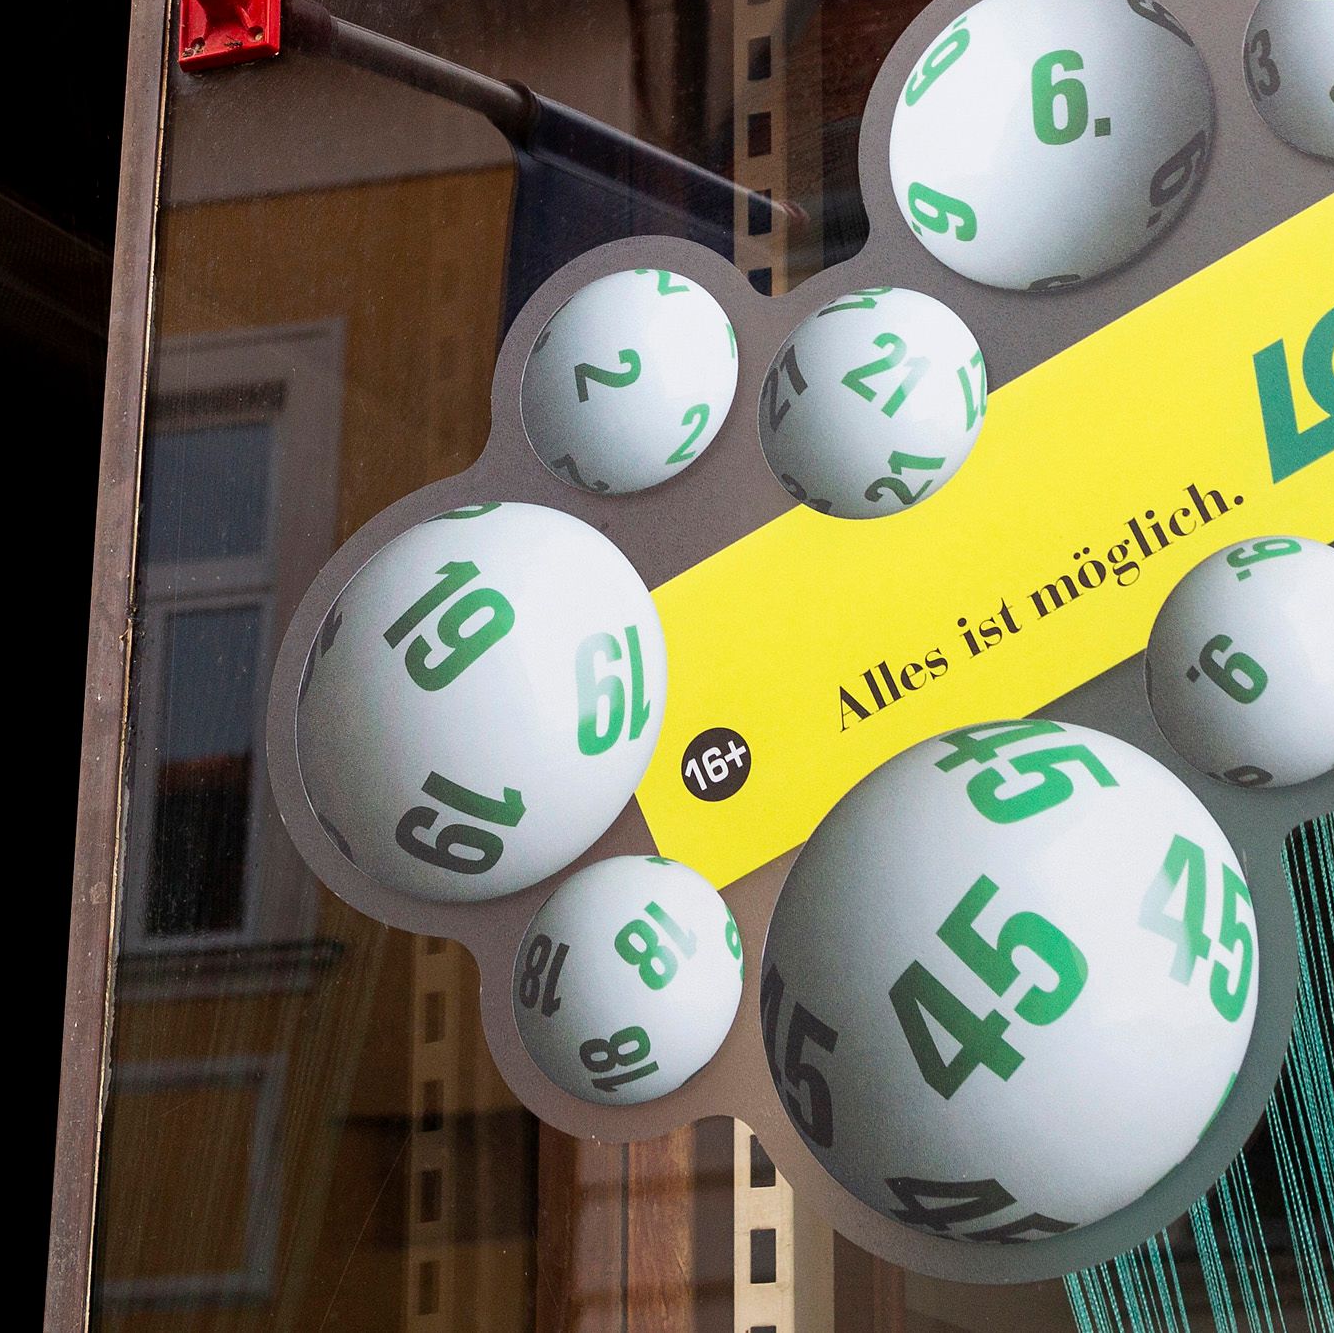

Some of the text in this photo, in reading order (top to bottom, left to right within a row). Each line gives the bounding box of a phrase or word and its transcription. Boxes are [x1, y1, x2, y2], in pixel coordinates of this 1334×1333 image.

[1031, 49, 1111, 145] 6.
[574, 349, 641, 403] 2
[841, 332, 930, 418] 21
[665, 403, 710, 465] 2
[864, 450, 946, 505] 21
[383, 560, 515, 691] 19
[838, 482, 1244, 733] Alles ist möglich.
[575, 625, 651, 756] 19
[684, 739, 747, 791] 16+
[395, 771, 527, 874] 19
[614, 900, 697, 990] 18
[1138, 833, 1253, 1023] 45
[888, 874, 1089, 1101] 45
[579, 1026, 659, 1093] 18
